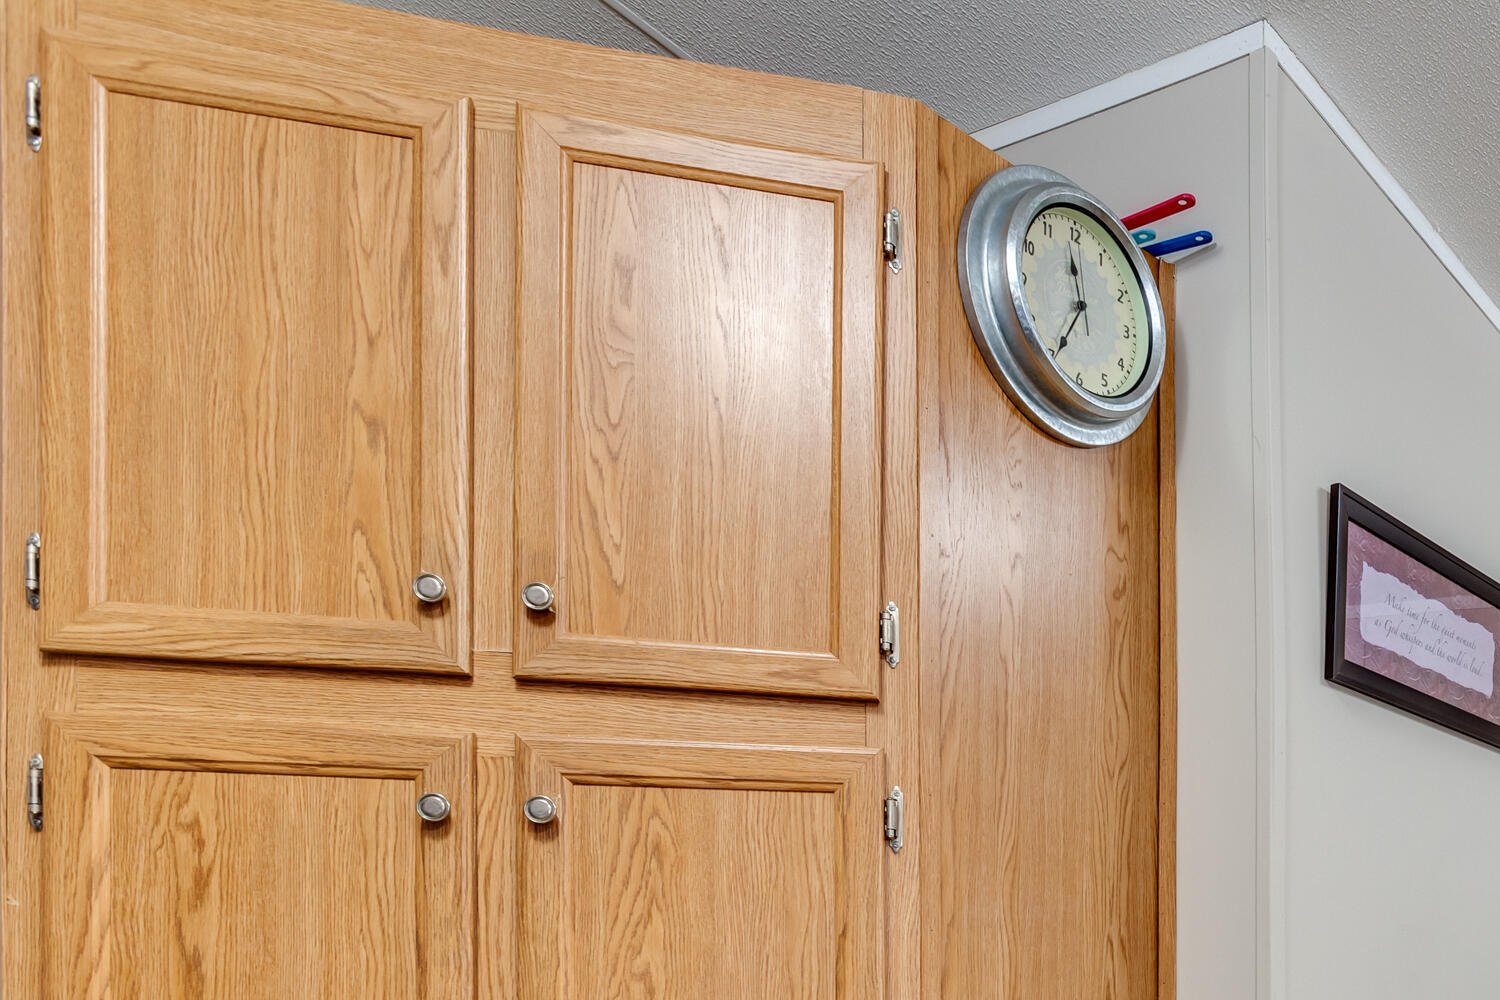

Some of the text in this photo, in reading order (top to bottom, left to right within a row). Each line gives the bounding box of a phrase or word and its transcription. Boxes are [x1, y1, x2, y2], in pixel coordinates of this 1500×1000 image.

[1042, 221, 1053, 239] 11
[1069, 226, 1081, 245] 12
[1024, 239, 1035, 256] 10
[1098, 252, 1103, 267] 1
[1117, 288, 1124, 304] 2
[1123, 324, 1130, 339] 3
[1117, 358, 1125, 372] 4
[1075, 372, 1083, 386] 6
[1101, 373, 1108, 387] 5
[1384, 619, 1404, 638] God
